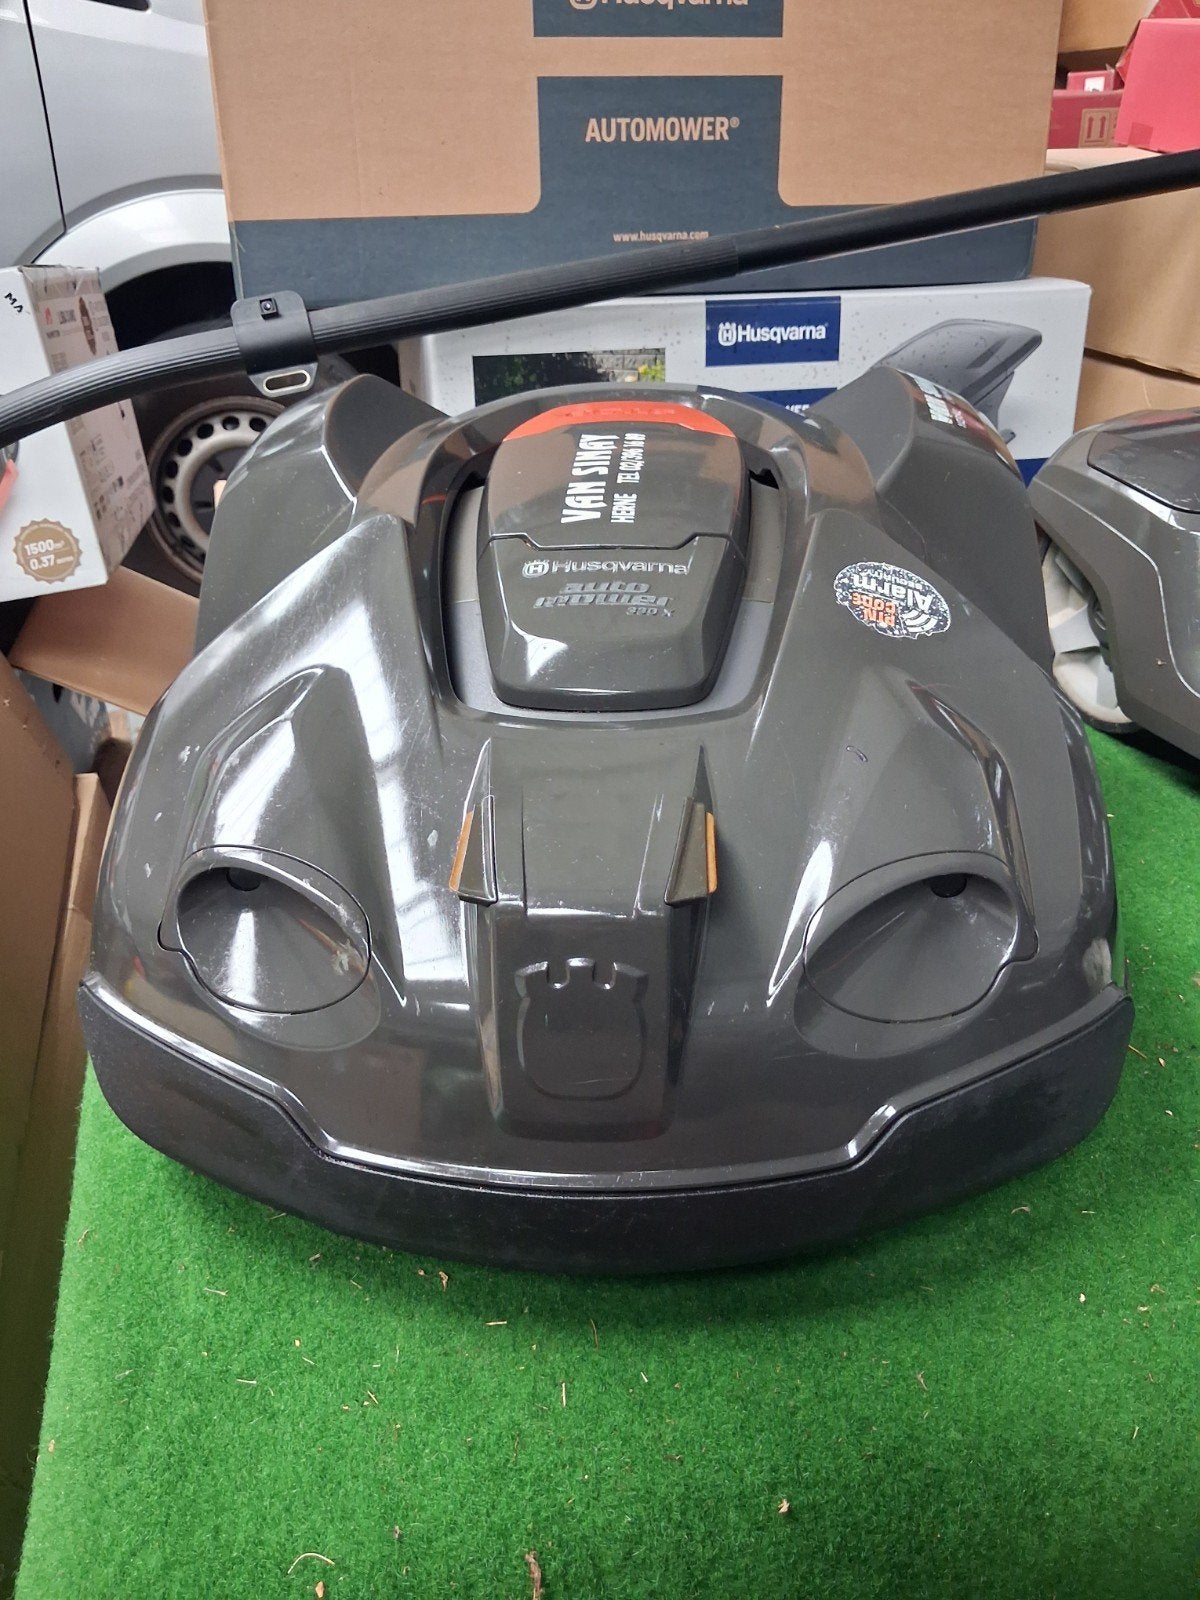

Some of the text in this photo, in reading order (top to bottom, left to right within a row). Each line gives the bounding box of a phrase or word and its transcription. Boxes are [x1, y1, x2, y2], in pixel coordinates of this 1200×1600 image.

[613, 230, 709, 243] www.husqvarna.com
[737, 323, 826, 344] Husqvarna
[560, 433, 620, 524] VAN SINAY
[616, 471, 640, 484] TEL
[610, 493, 638, 524] HERNE
[551, 559, 690, 576] Husqvarna
[850, 591, 897, 614] CODE
[851, 572, 934, 614] Alarm
[862, 607, 896, 628] PIN
